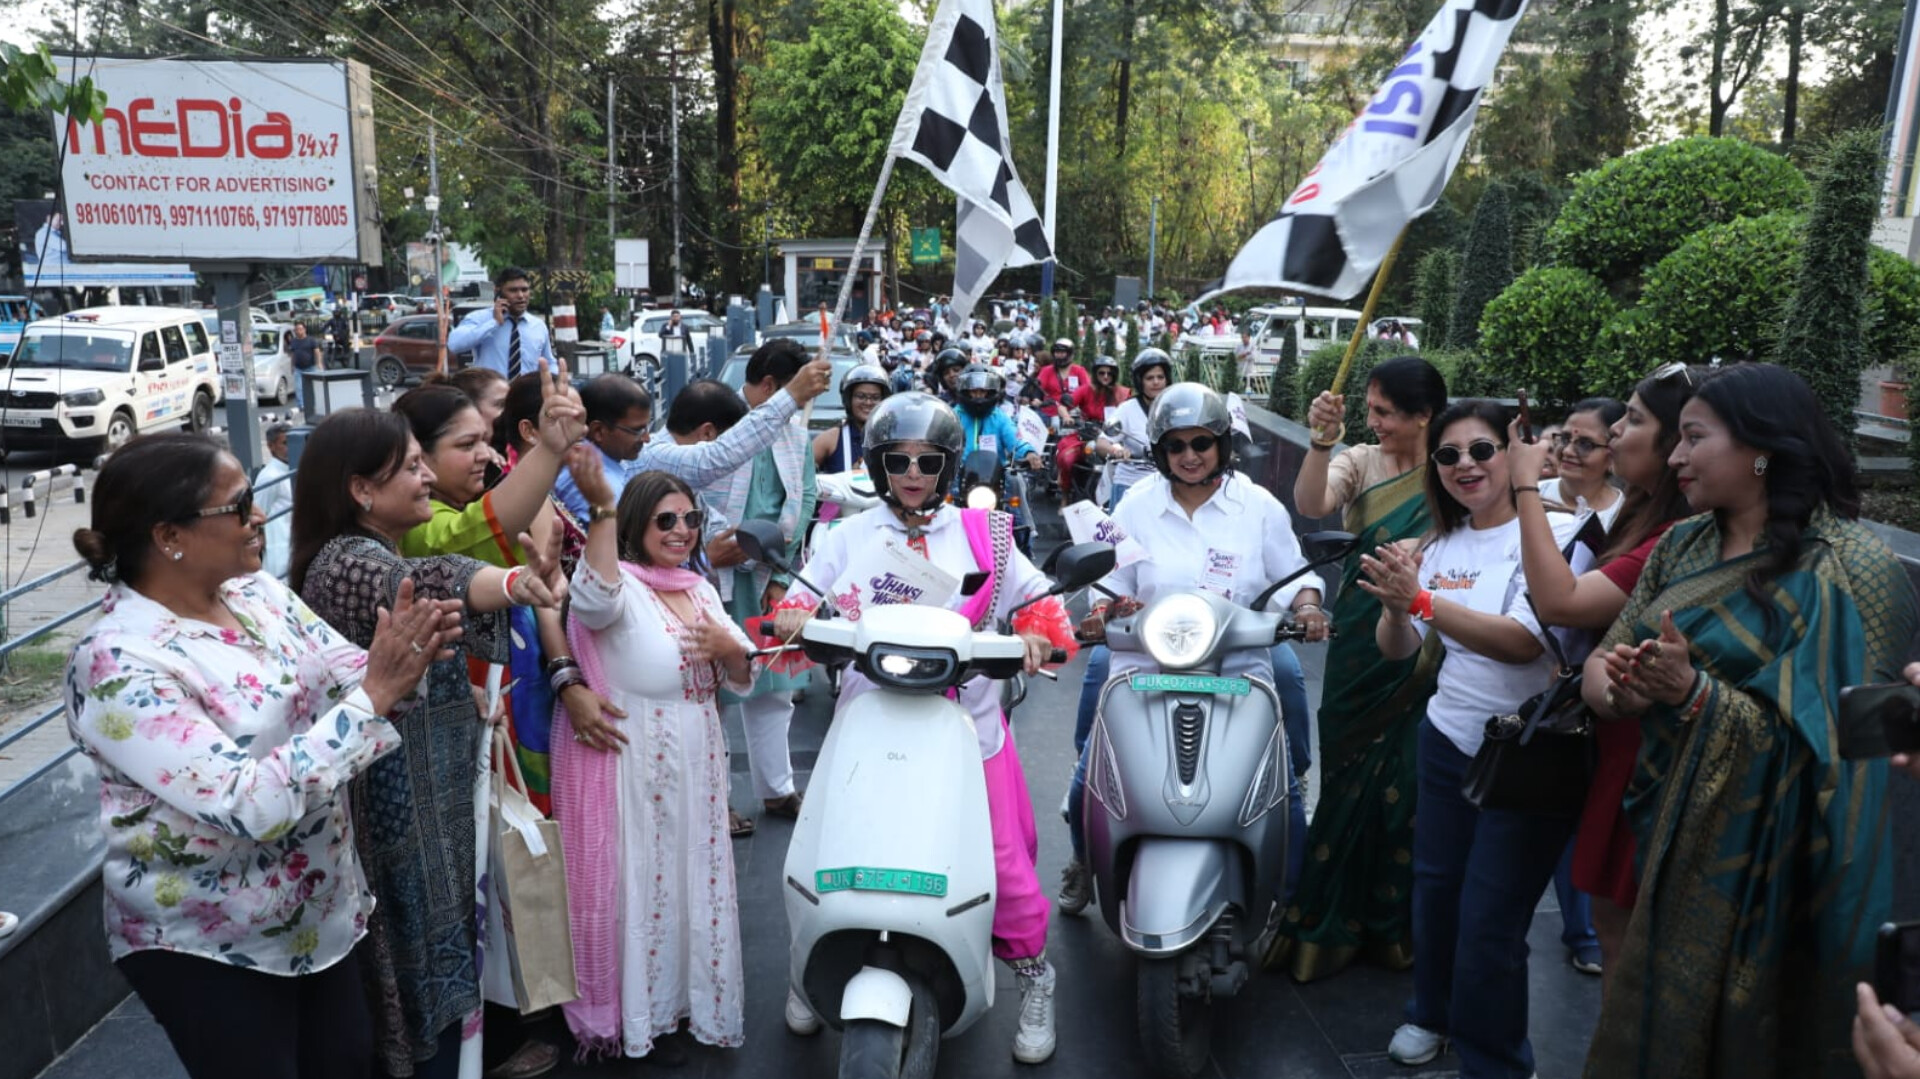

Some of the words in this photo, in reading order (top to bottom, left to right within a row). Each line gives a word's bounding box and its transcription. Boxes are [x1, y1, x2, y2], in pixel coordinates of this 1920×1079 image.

[90, 174, 171, 192] CONTACT
[176, 176, 211, 192] FOR
[215, 176, 328, 192] ADVERTISING
[75, 202, 167, 231] 9810610179,
[170, 204, 261, 231] 9971110766,
[262, 205, 348, 227] 9719778005
[869, 572, 923, 600] JHANSI
[887, 751, 907, 761] OLA
